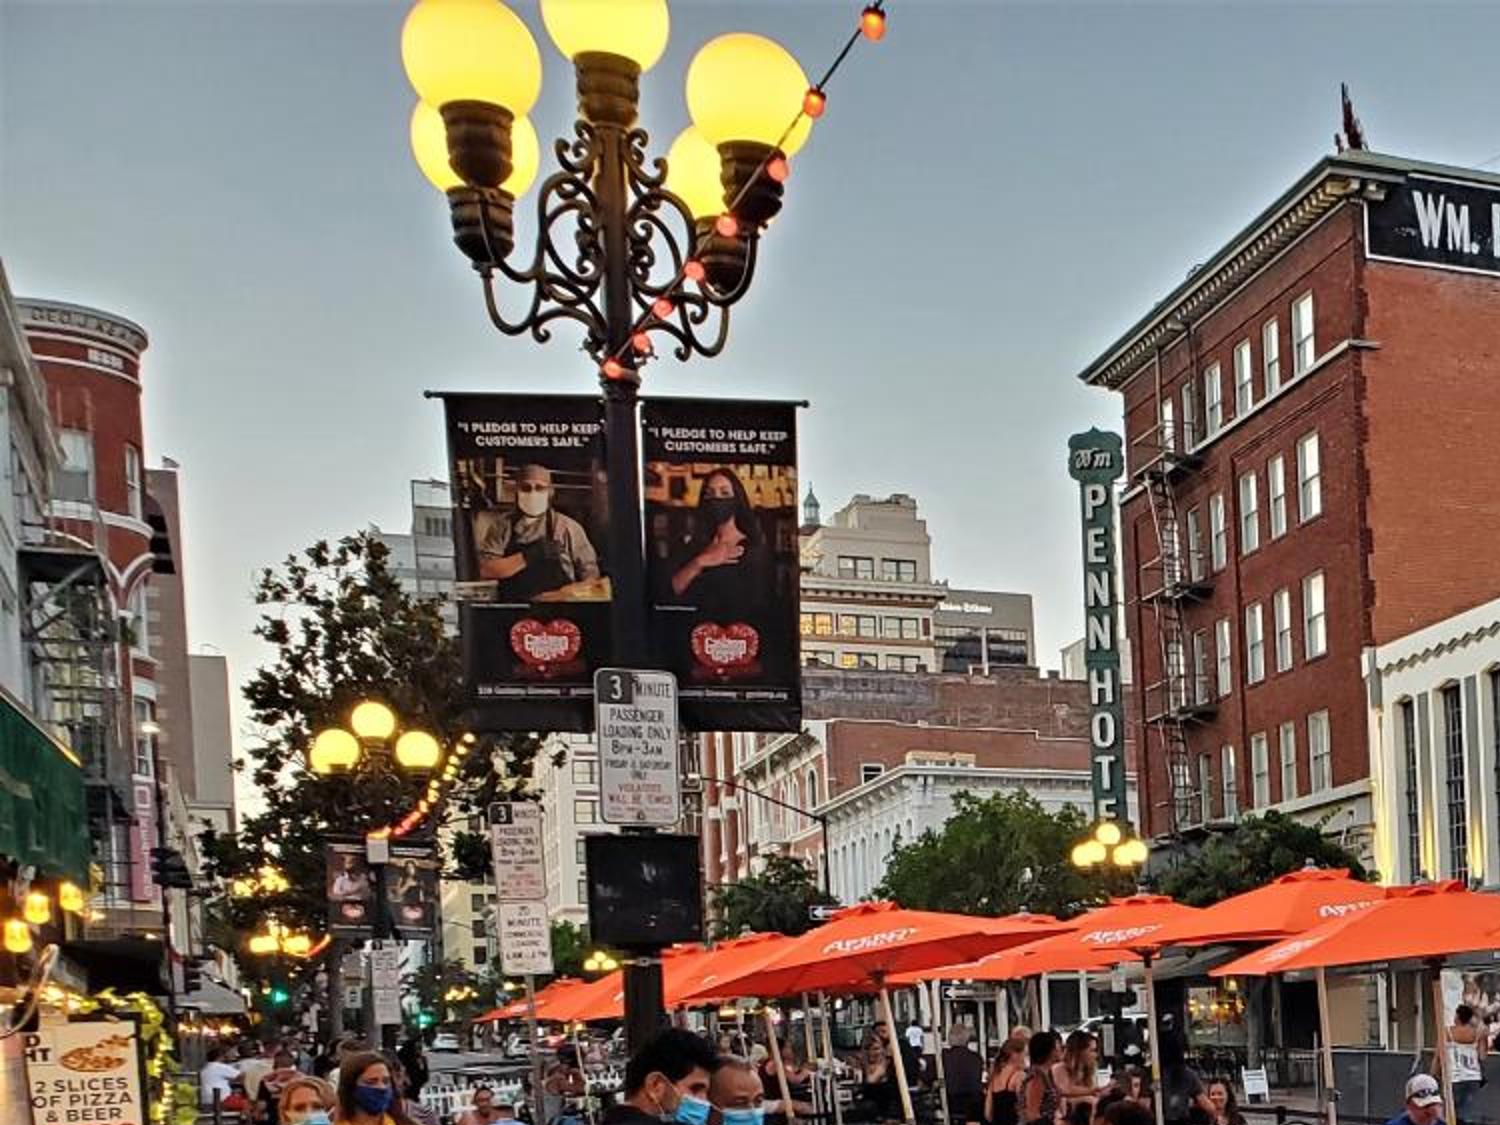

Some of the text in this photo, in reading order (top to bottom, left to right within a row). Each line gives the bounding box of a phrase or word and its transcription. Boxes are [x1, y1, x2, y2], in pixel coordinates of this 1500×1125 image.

[471, 421, 517, 433] PLEDGE
[520, 423, 537, 433] TO
[540, 423, 569, 433] HELP
[571, 423, 600, 435] KEEP
[662, 427, 706, 439] PLEDGE
[709, 429, 725, 440] TO
[728, 430, 757, 440] HELP
[760, 431, 788, 442] KEEP
[475, 435, 549, 447] CUSTOMERS
[665, 441, 737, 453] CUSTOMERS
[1085, 483, 1111, 652] PENN
[610, 675, 622, 700] 3
[635, 683, 672, 698] MINUTE
[609, 707, 665, 723] PASSENGER
[603, 724, 671, 741] LOADING ONLY
[1090, 667, 1118, 822] HOTE
[35, 1077, 129, 1093] 2 SLICES
[32, 1092, 133, 1109] OF PIZZA
[46, 1107, 122, 1123] & BEER
